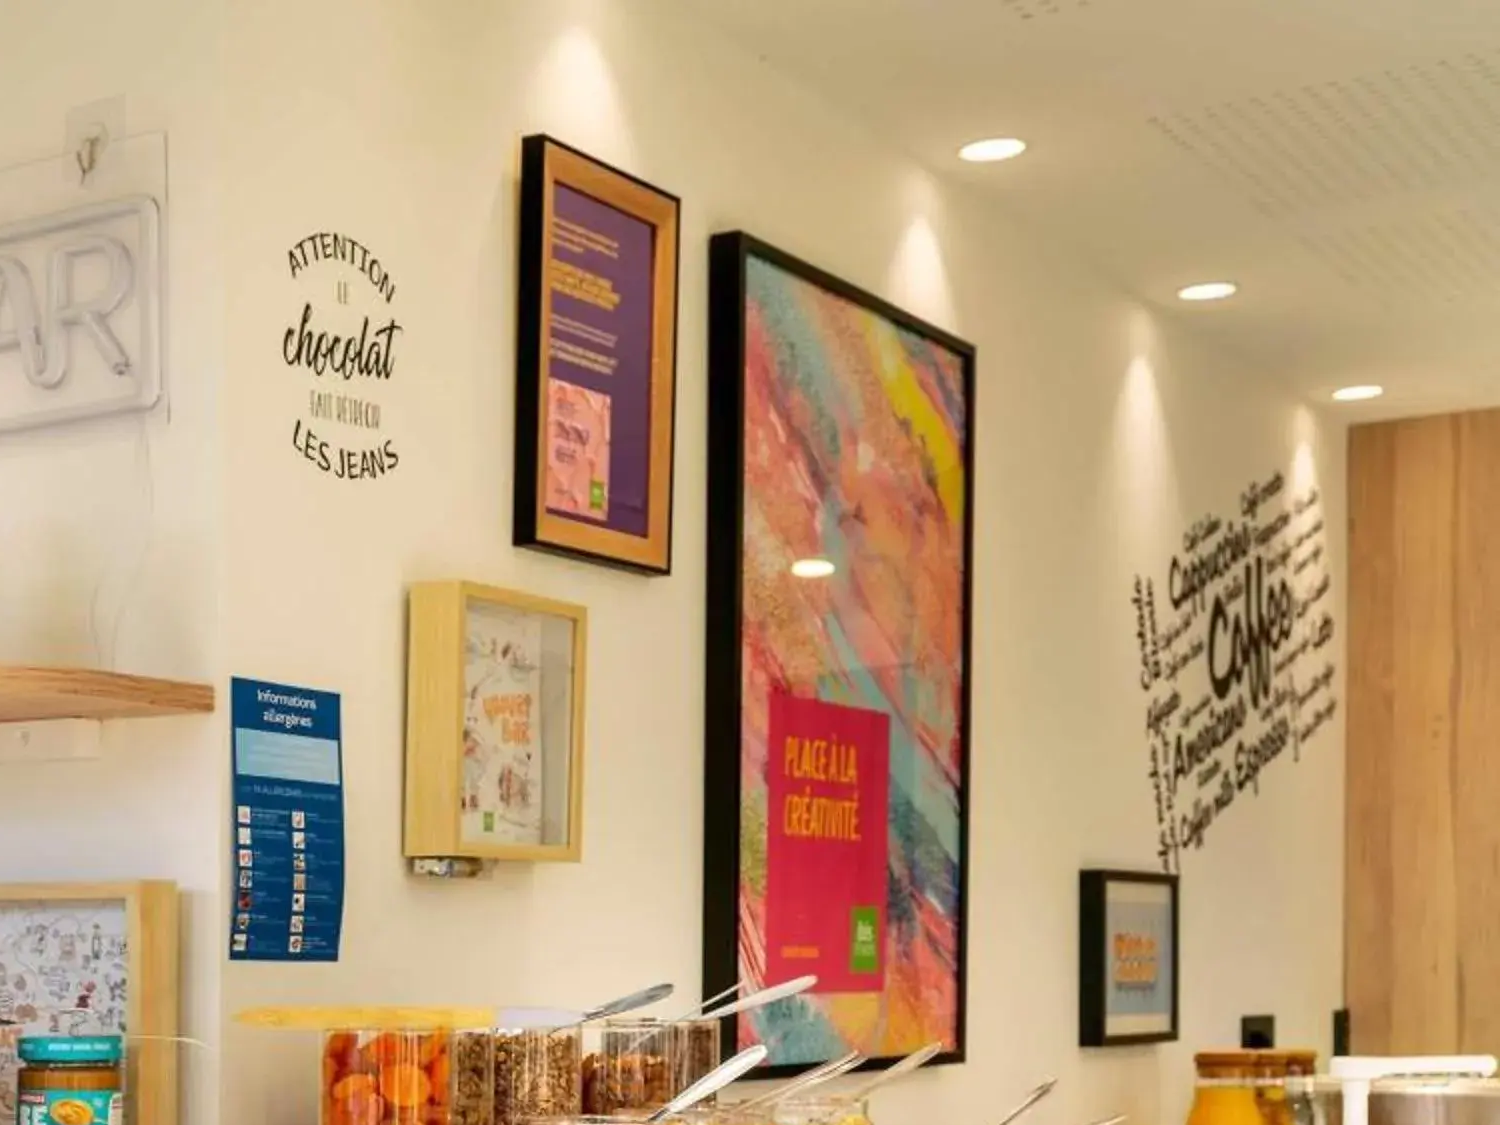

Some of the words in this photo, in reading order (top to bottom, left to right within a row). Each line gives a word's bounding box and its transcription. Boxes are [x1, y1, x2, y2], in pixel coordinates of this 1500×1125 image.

[287, 232, 396, 304] ATTENTION
[283, 302, 403, 379] chocolat
[293, 419, 330, 472] LES
[334, 440, 398, 480] JEANS
[257, 688, 317, 710] Informations
[785, 735, 827, 781] PLACE
[840, 745, 858, 784] LA
